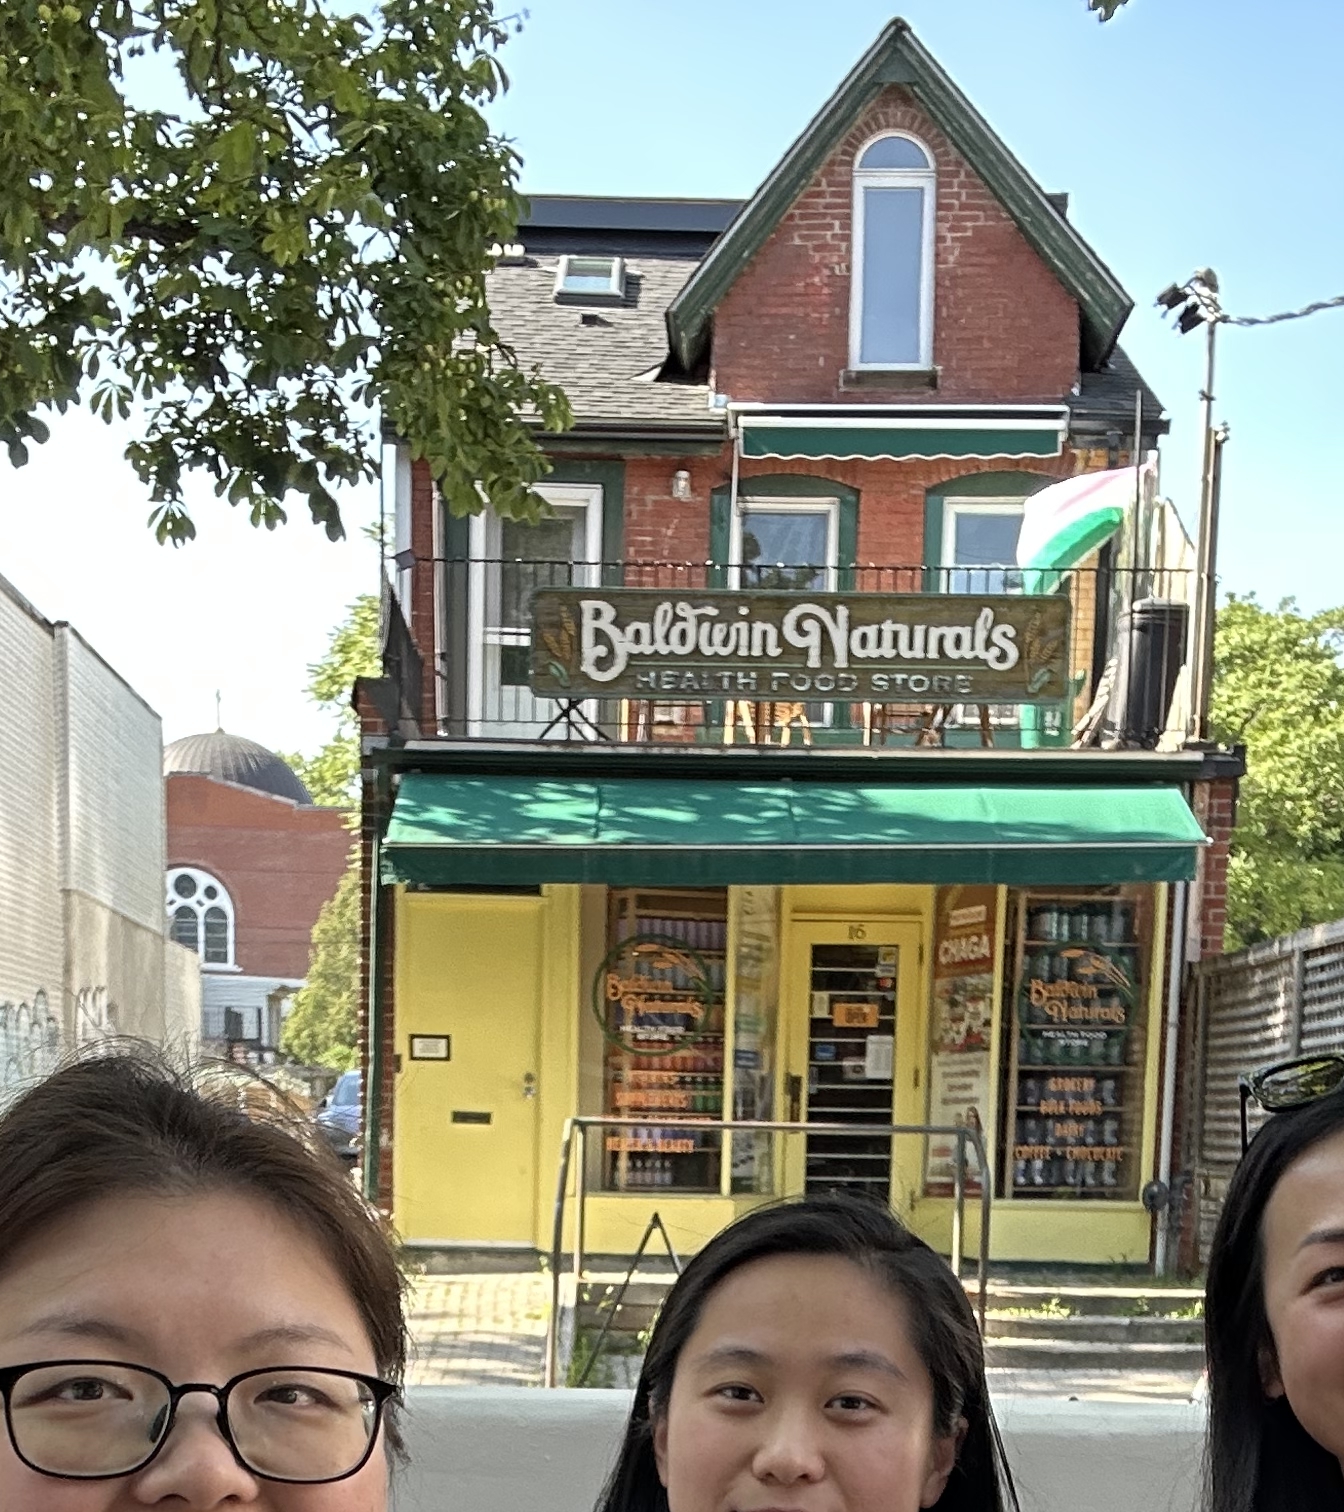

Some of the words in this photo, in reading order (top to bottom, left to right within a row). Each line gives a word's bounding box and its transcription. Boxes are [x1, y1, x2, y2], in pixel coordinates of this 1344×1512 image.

[581, 600, 783, 681] Baldwin
[783, 603, 1019, 669] Naturals
[637, 671, 757, 692] HEALTH
[772, 672, 859, 693] FOOD
[871, 673, 973, 694] STORE
[848, 924, 867, 940] 16
[938, 934, 991, 965] CHAGA
[1031, 979, 1097, 1007] Baldwin
[1044, 998, 1126, 1023] Naturals
